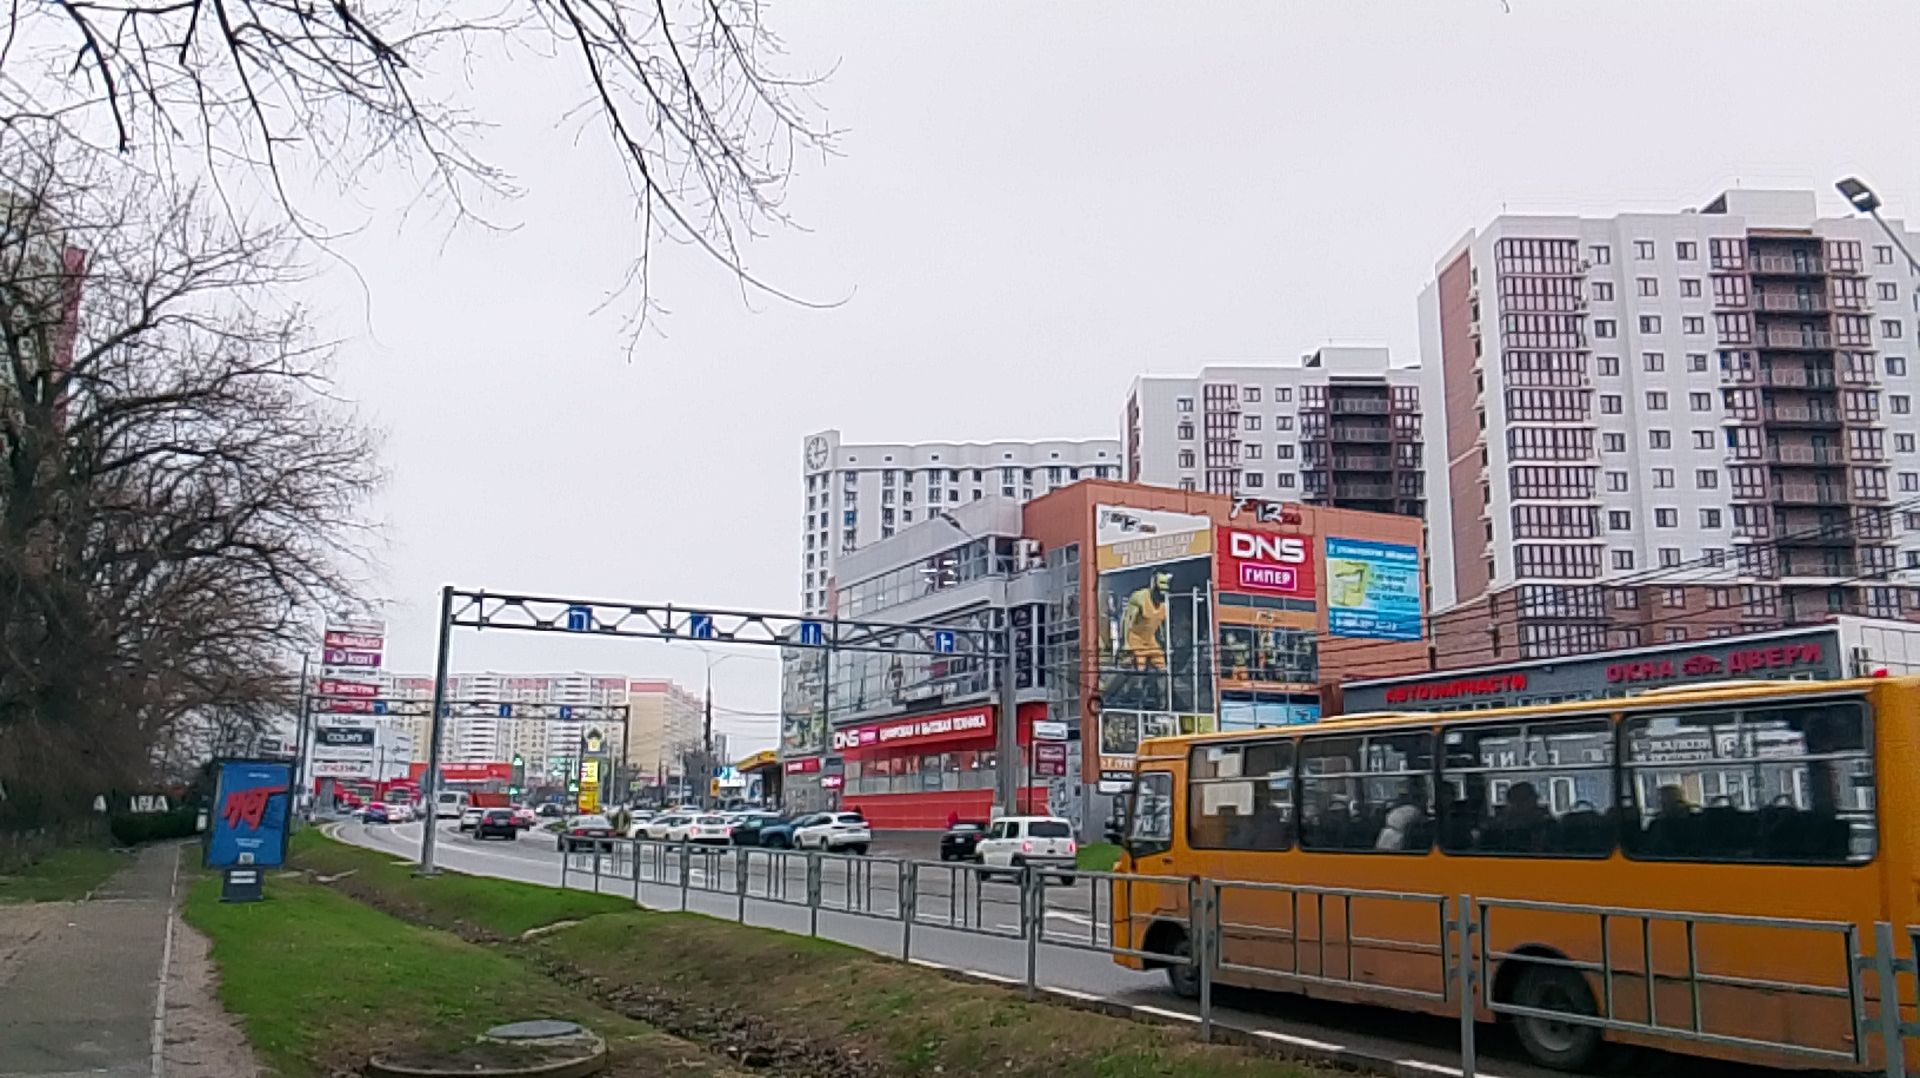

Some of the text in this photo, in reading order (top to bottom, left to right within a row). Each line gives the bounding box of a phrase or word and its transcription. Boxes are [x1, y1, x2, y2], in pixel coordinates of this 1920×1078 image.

[1231, 532, 1305, 563] DNS
[1245, 568, 1291, 584] ГИПЕР
[1605, 659, 1674, 682] ОКНА
[1727, 643, 1823, 673] ДВЕРИ
[1385, 673, 1527, 703] АВТОЗАПЧАСТИ
[833, 729, 860, 749] DNS
